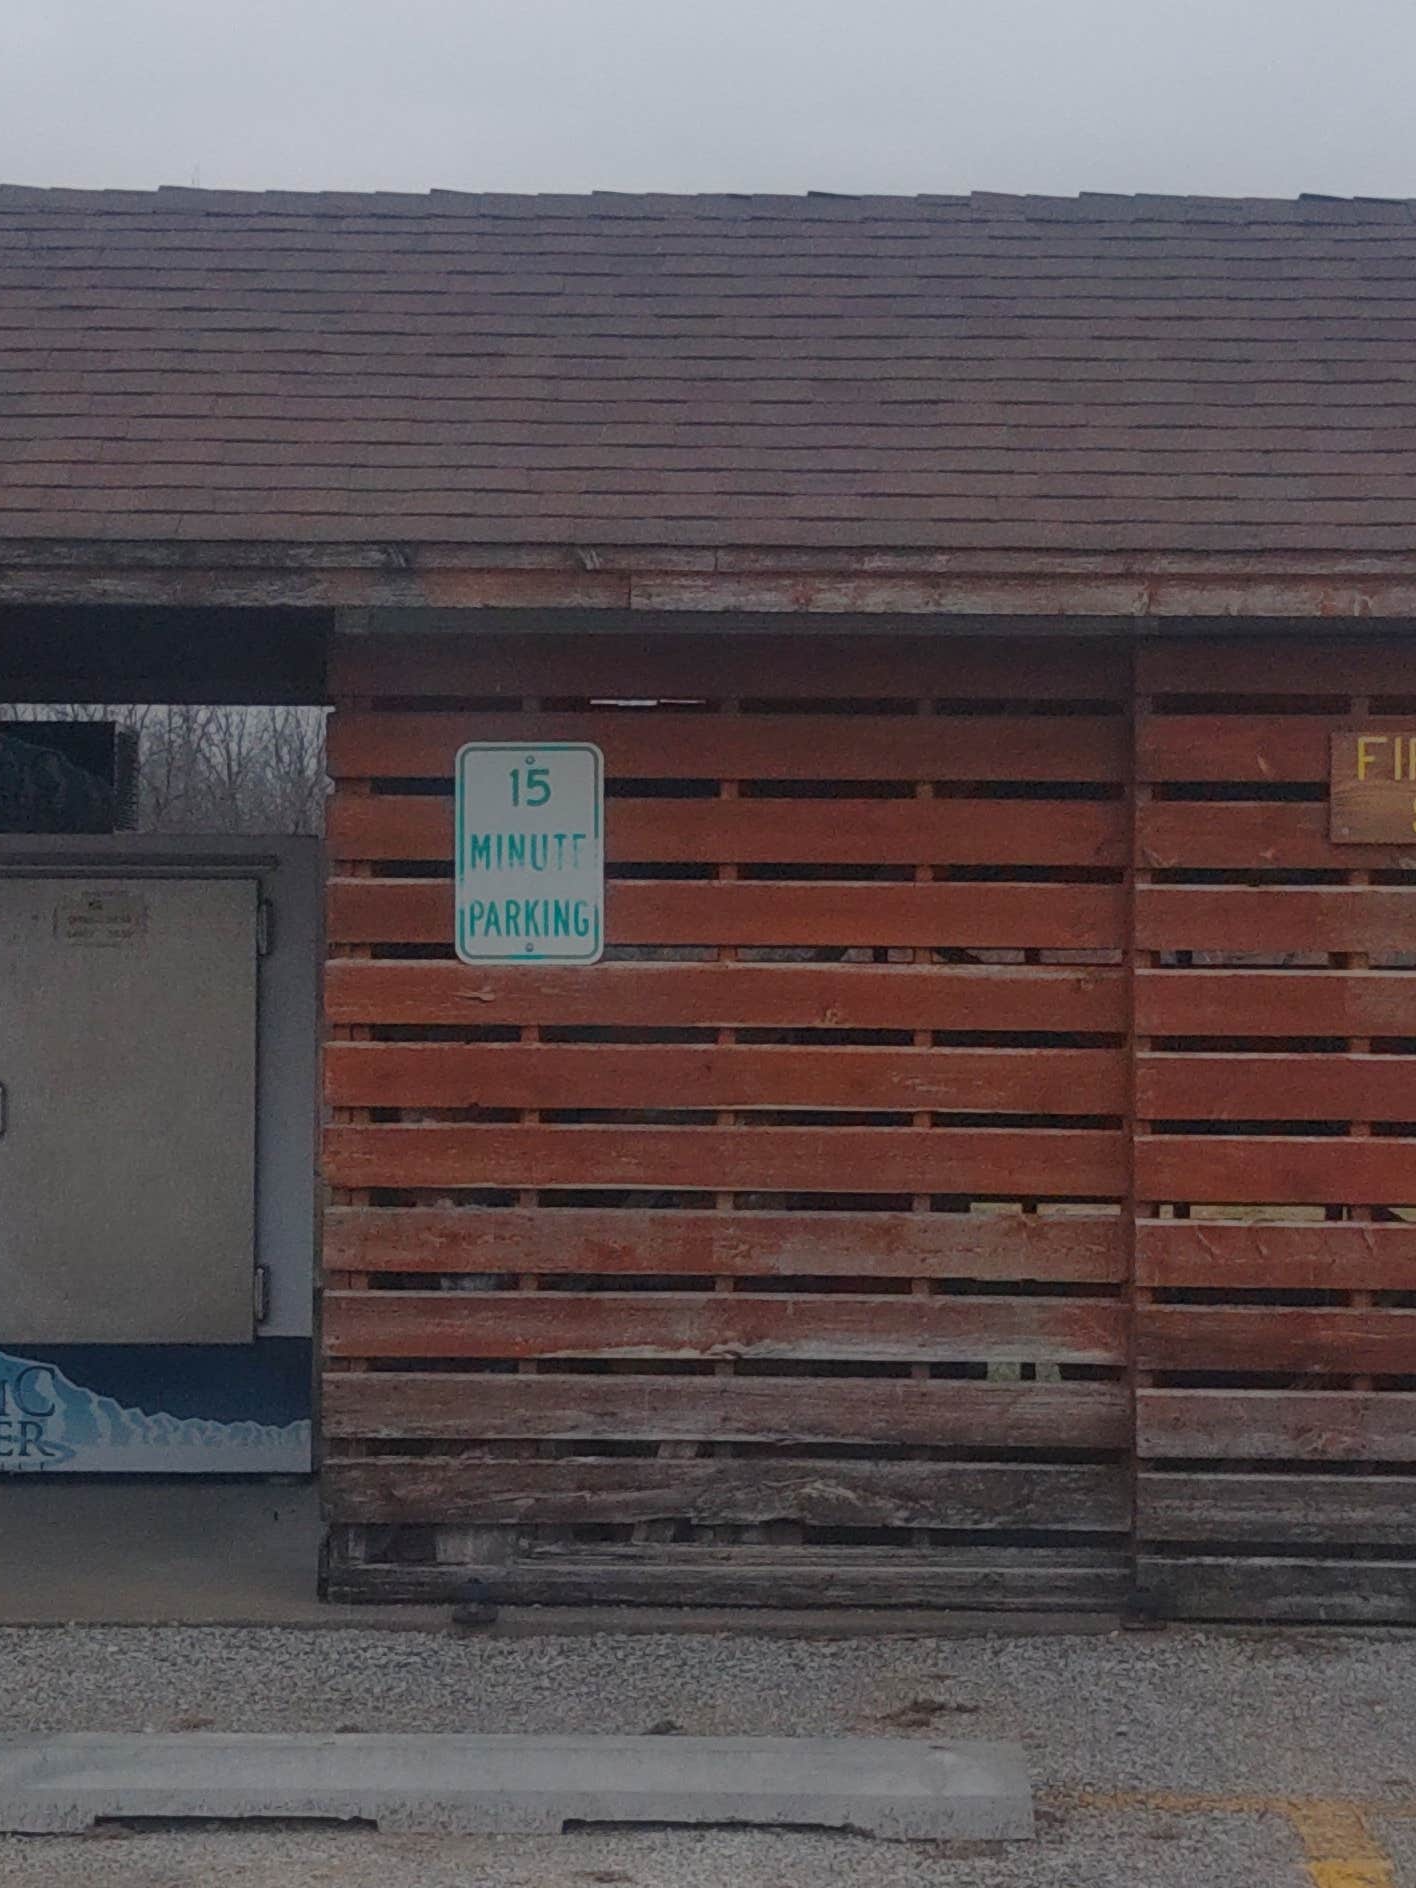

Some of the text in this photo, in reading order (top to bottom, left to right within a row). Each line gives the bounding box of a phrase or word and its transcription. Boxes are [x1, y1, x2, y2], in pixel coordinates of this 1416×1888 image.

[509, 768, 552, 807] 15
[470, 833, 587, 872] MINUTE
[468, 898, 591, 937] PARKING
